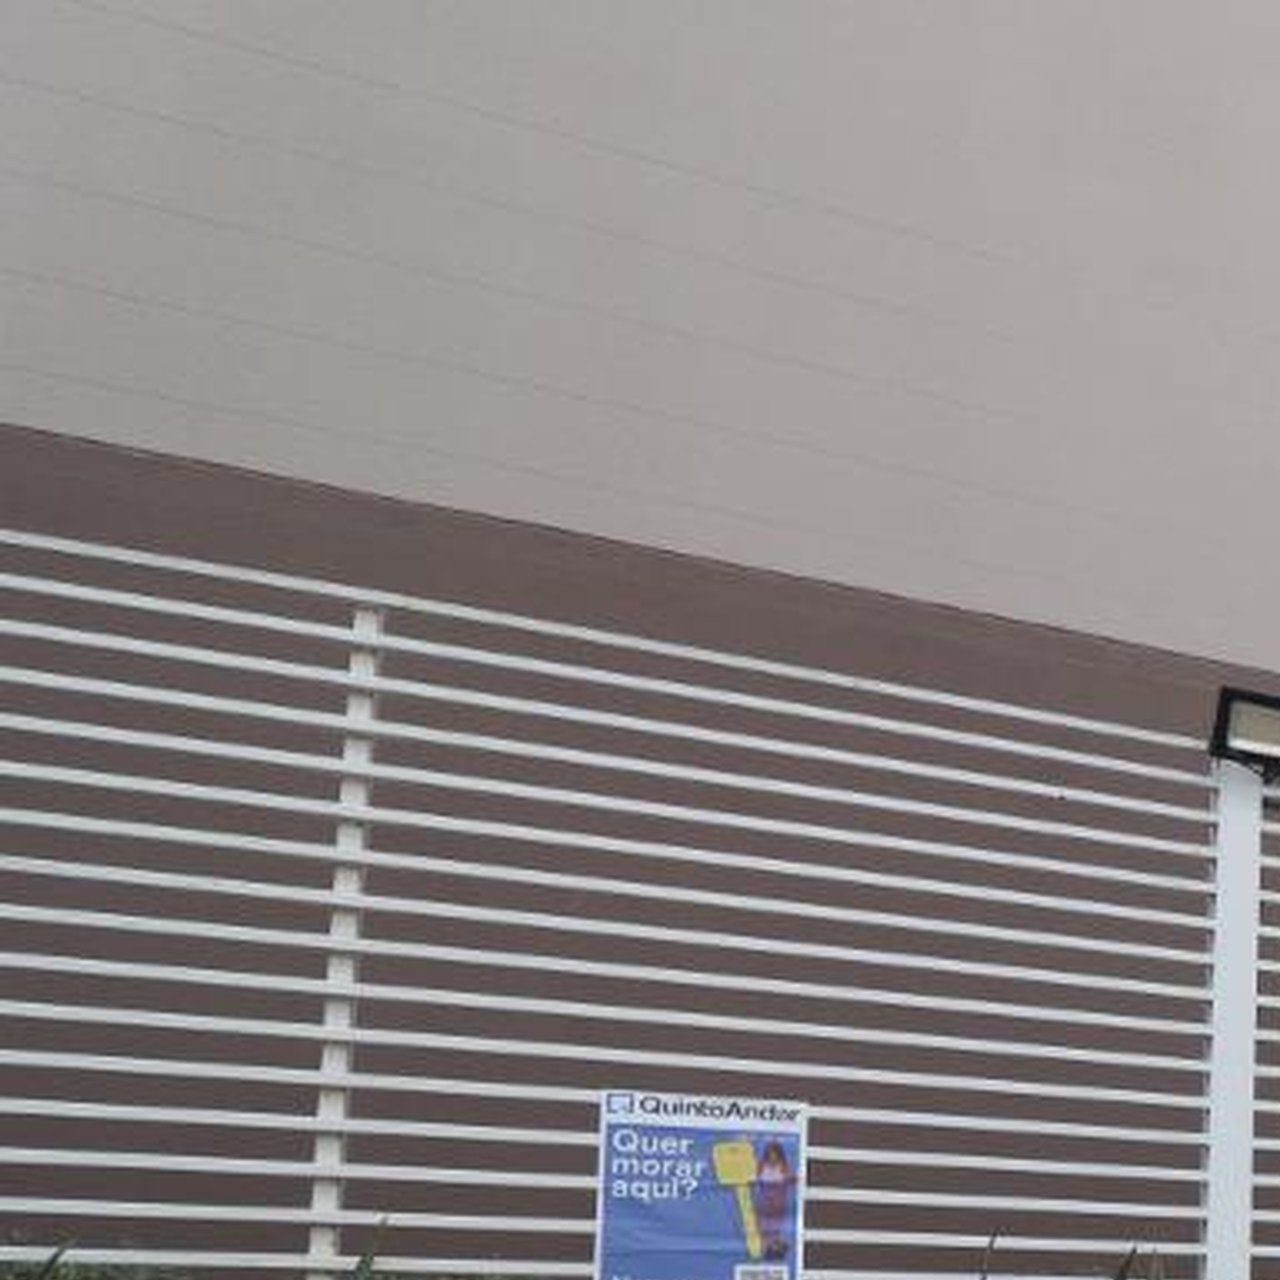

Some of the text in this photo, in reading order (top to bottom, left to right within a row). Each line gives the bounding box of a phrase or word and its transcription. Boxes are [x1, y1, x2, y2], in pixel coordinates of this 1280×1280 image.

[639, 1095, 800, 1121] QuintoAndar
[612, 1129, 694, 1155] Quer
[612, 1155, 702, 1177] morar
[612, 1178, 698, 1203] aqui?
